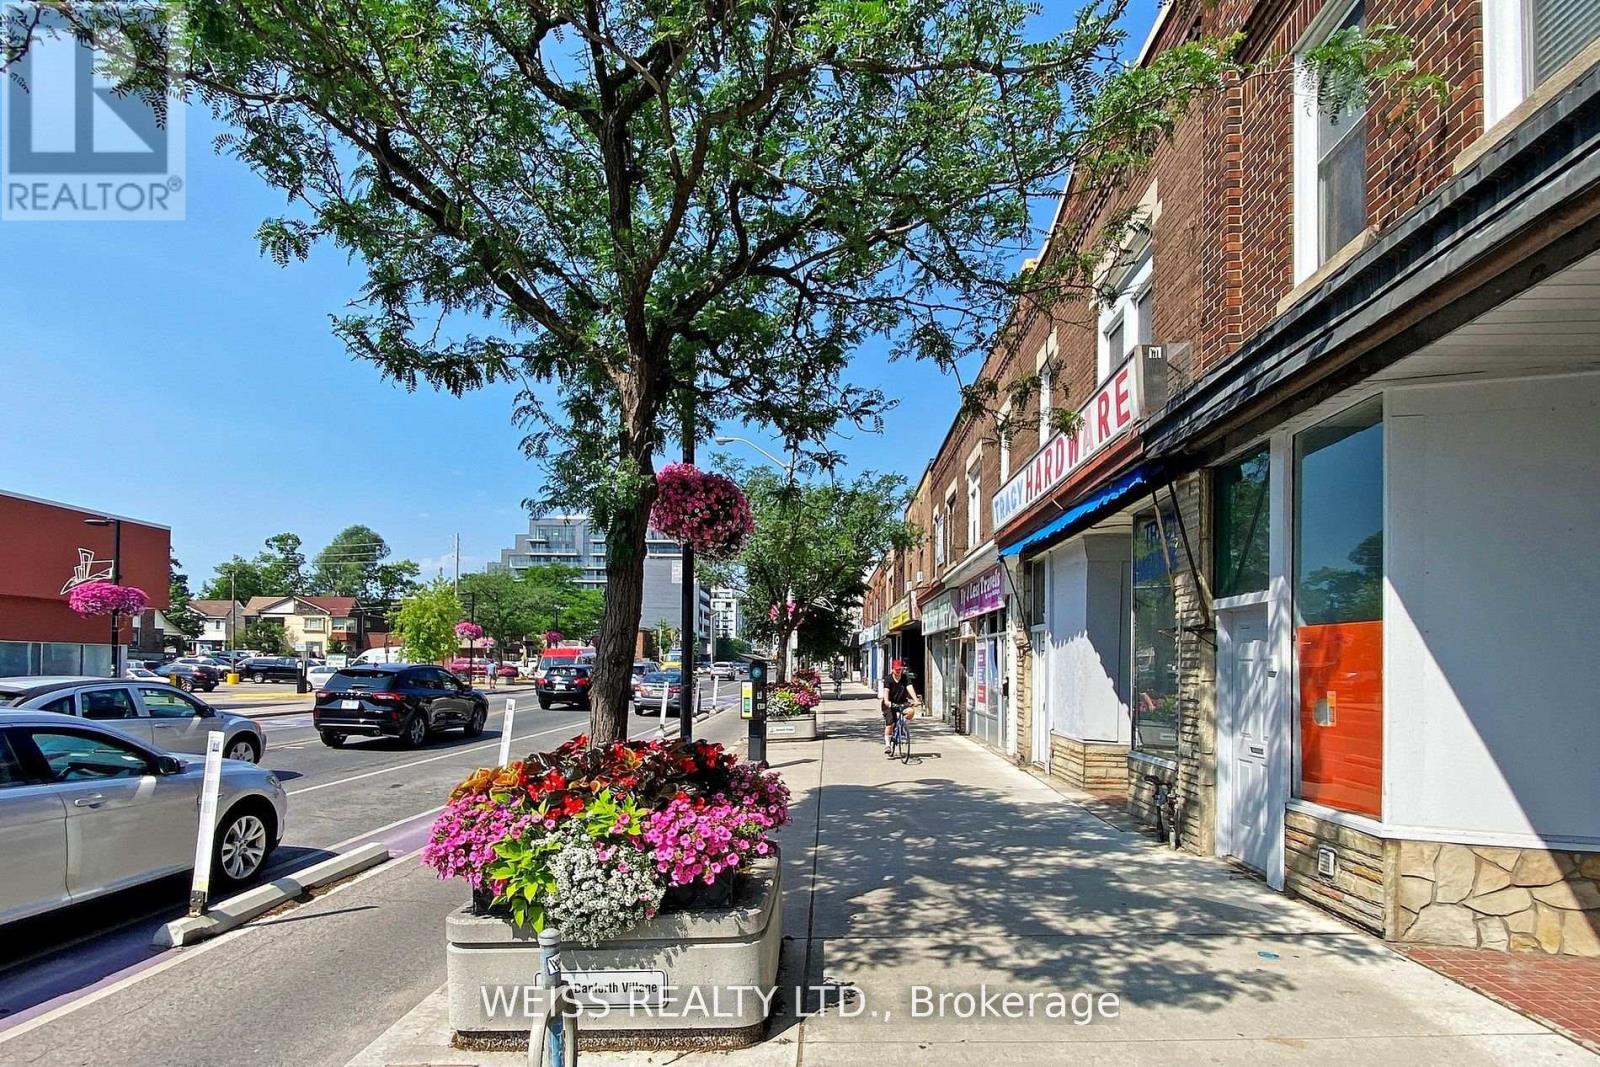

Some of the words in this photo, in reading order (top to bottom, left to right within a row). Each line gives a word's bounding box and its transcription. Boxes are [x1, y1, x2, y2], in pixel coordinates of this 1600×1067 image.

[994, 478, 1024, 524] TRACY
[1026, 368, 1131, 503] HARDWARE
[574, 983, 619, 994] Danforth
[622, 982, 658, 996] Village
